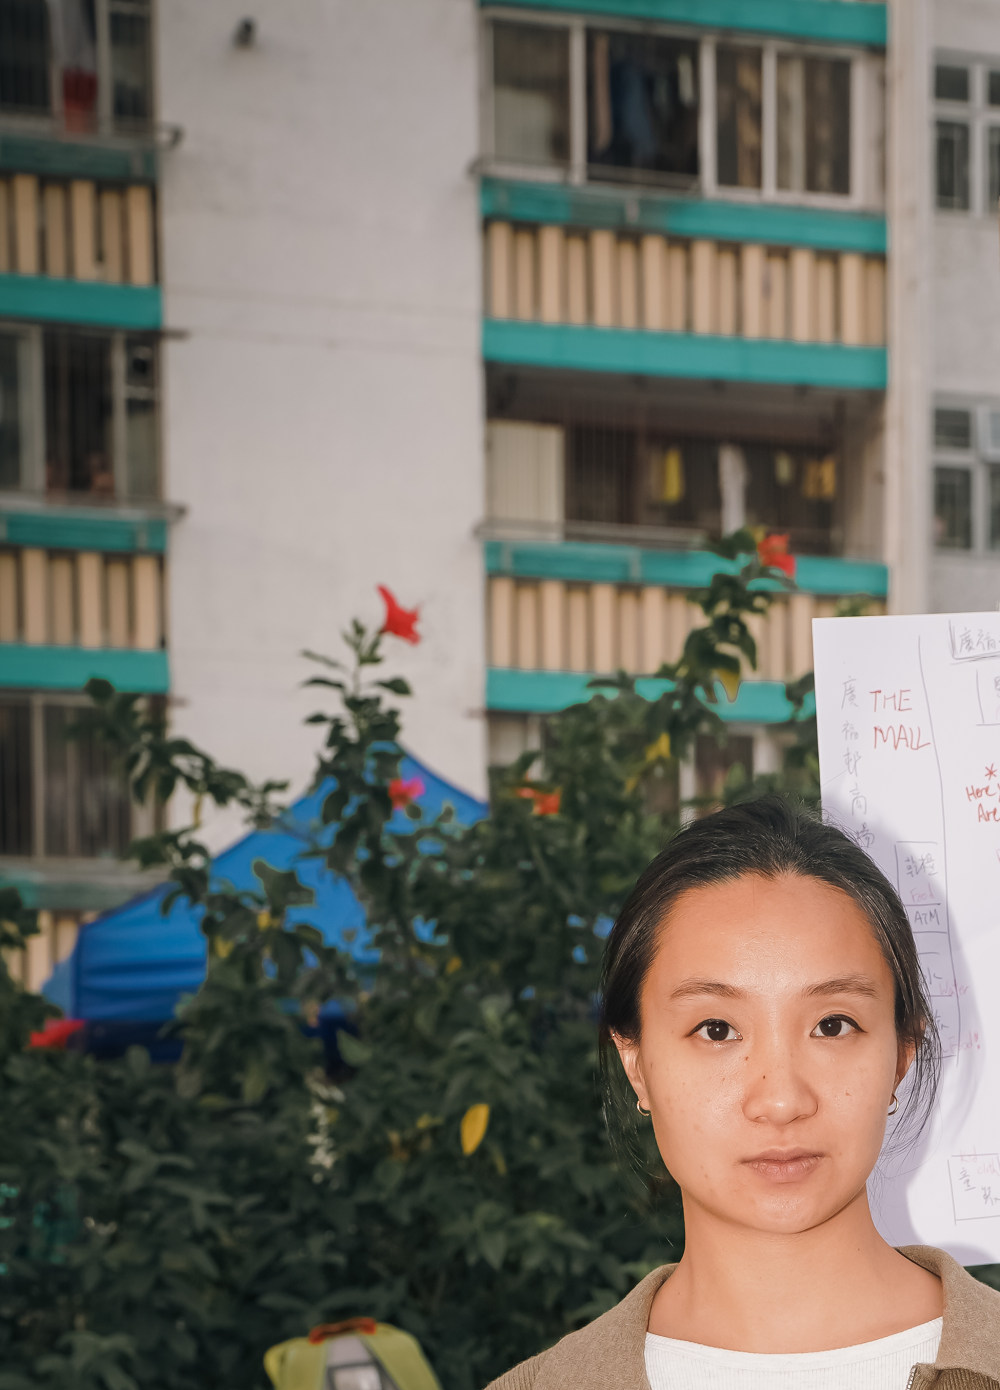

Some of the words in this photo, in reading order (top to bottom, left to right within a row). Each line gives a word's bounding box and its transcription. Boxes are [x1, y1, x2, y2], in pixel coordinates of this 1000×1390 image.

[870, 689, 912, 712] THE
[873, 724, 931, 750] MALL
[966, 783, 996, 801] Here
[914, 908, 940, 925] ATM
